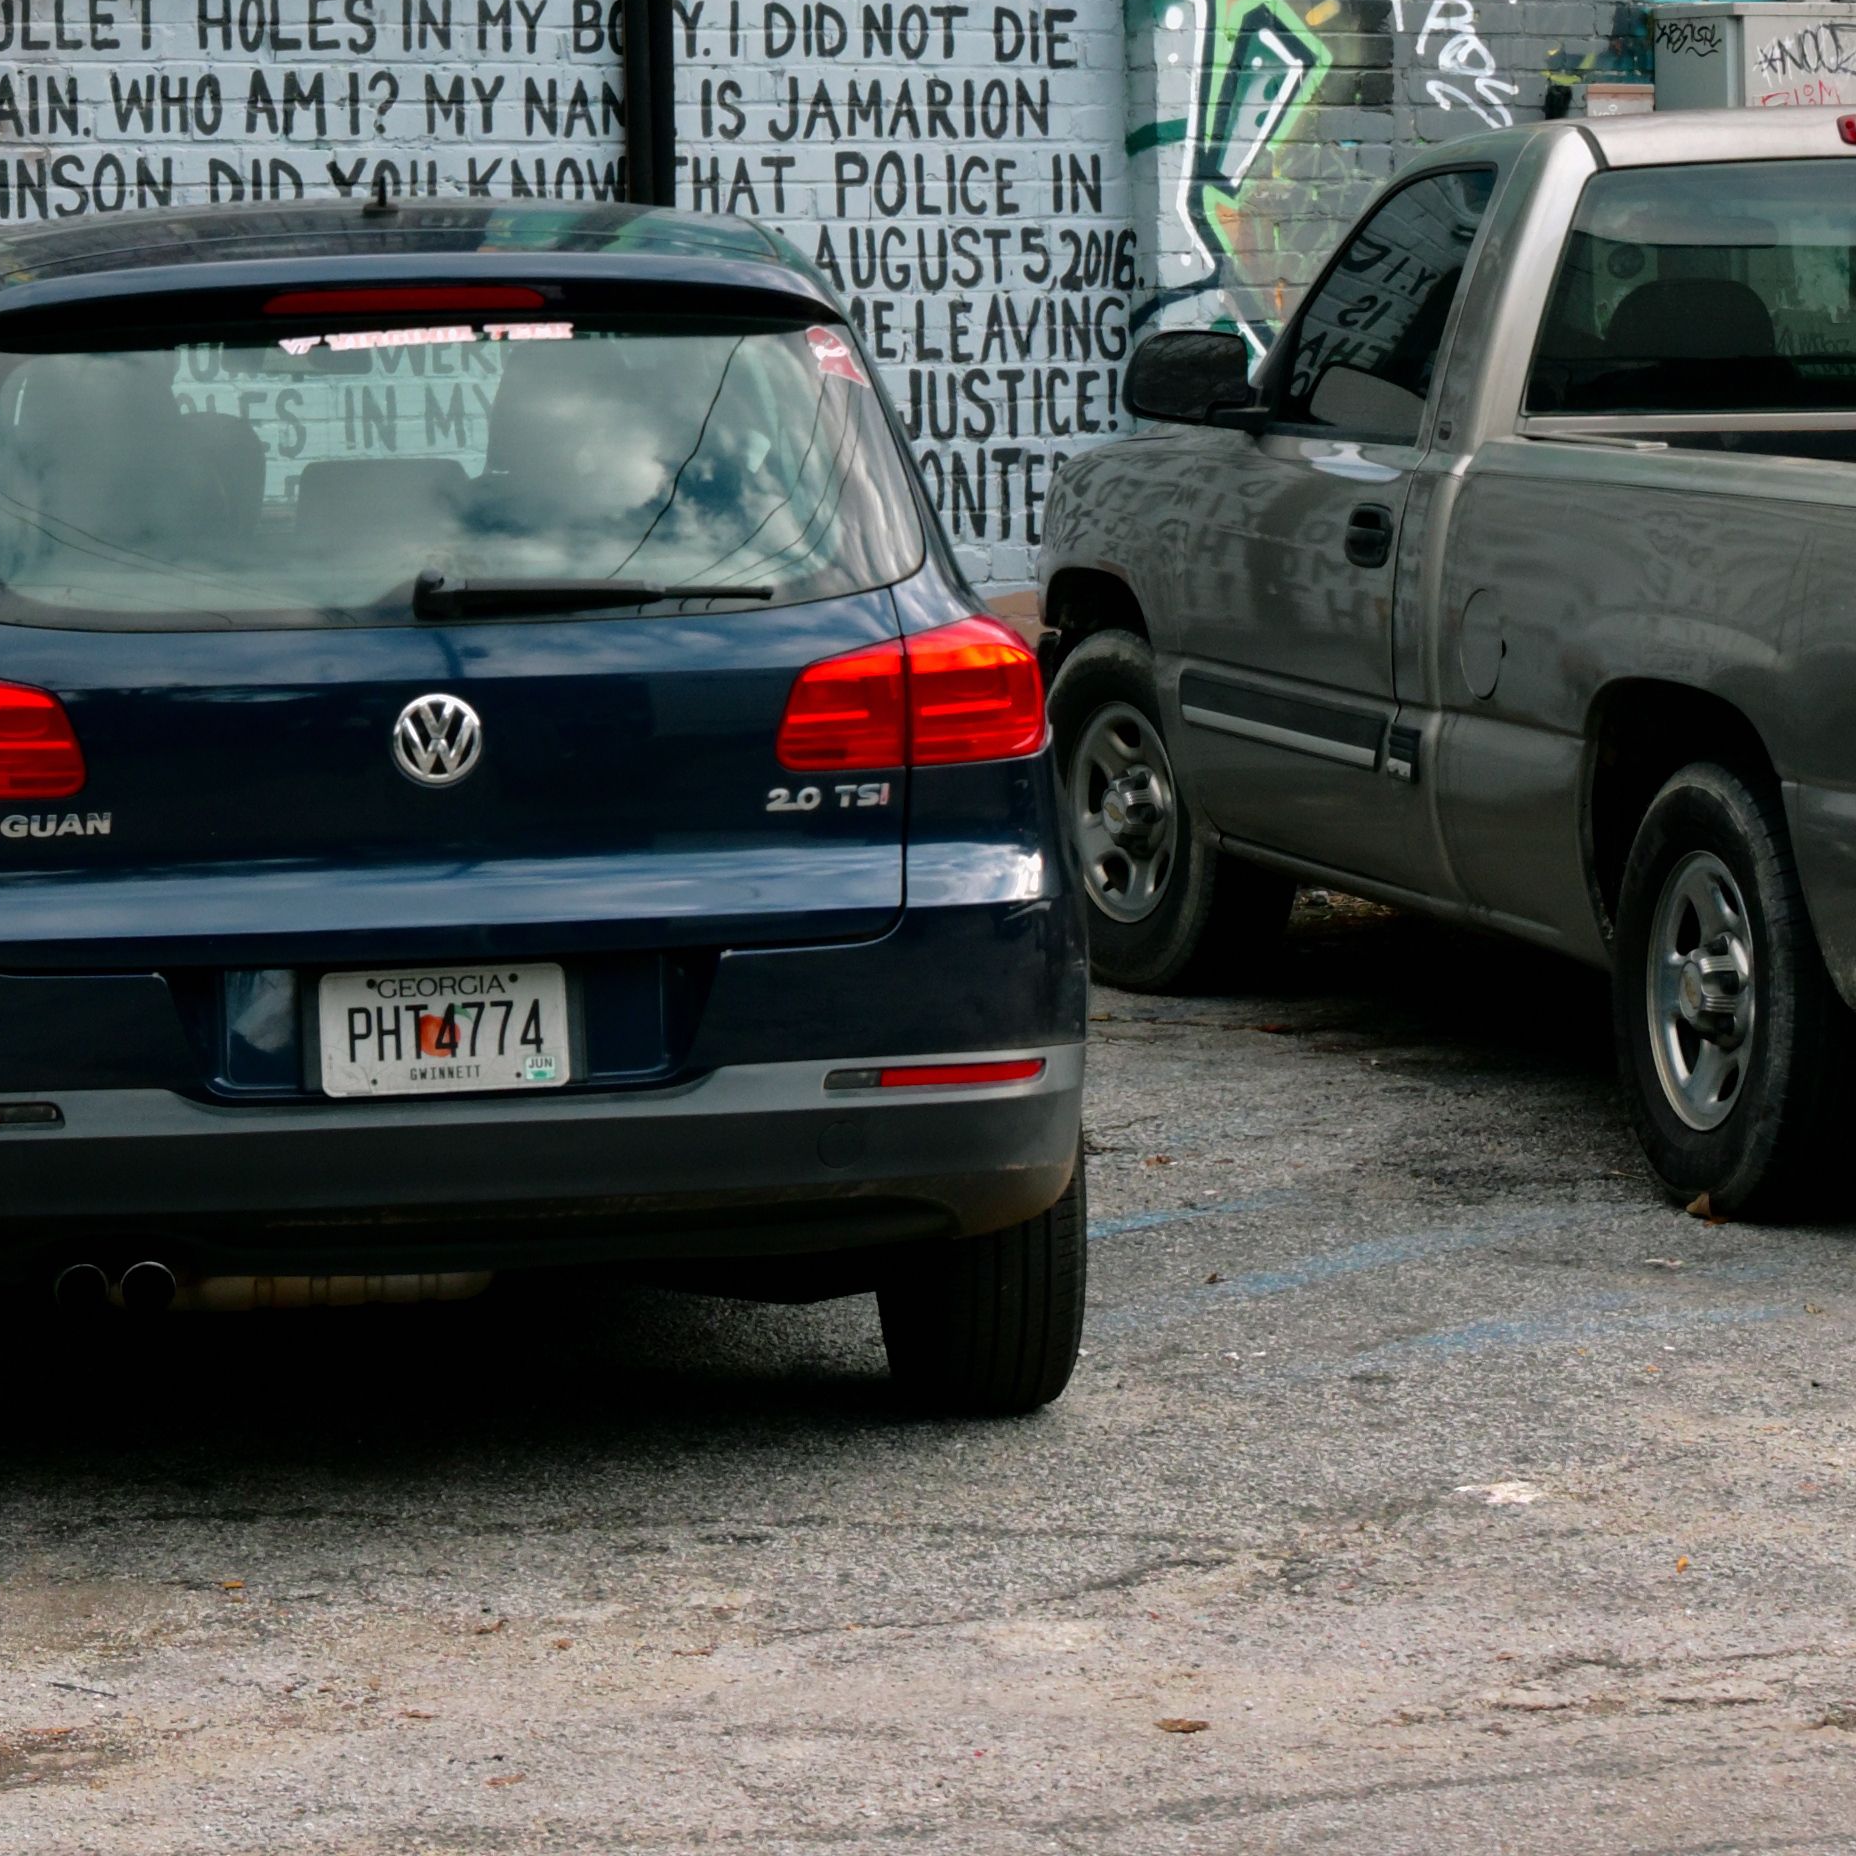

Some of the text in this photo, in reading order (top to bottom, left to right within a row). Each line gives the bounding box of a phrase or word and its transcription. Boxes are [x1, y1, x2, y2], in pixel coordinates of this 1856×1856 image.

[764, 2, 848, 59] DID
[863, 2, 969, 59] NOT
[994, 6, 1079, 69] DIE
[111, 70, 222, 137] WHO
[246, 70, 327, 138] AM
[425, 73, 505, 136] MY
[524, 75, 627, 137] NA
[701, 78, 746, 141] IS
[768, 75, 1050, 143] JAMARION
[209, 157, 303, 204] DID
[834, 150, 1020, 219] POLICE
[1052, 152, 1103, 215] IN
[815, 224, 1011, 292] AUGUST
[916, 293, 1129, 363] LEAVING
[899, 367, 1119, 442] JUSTICE!
[395, 695, 482, 783] VW
[835, 782, 890, 808] TSI
[377, 974, 505, 999] GEORGIA
[348, 999, 544, 1063] PHT4774
[528, 1057, 553, 1069] JUN
[410, 1065, 481, 1081] GWINNETT
